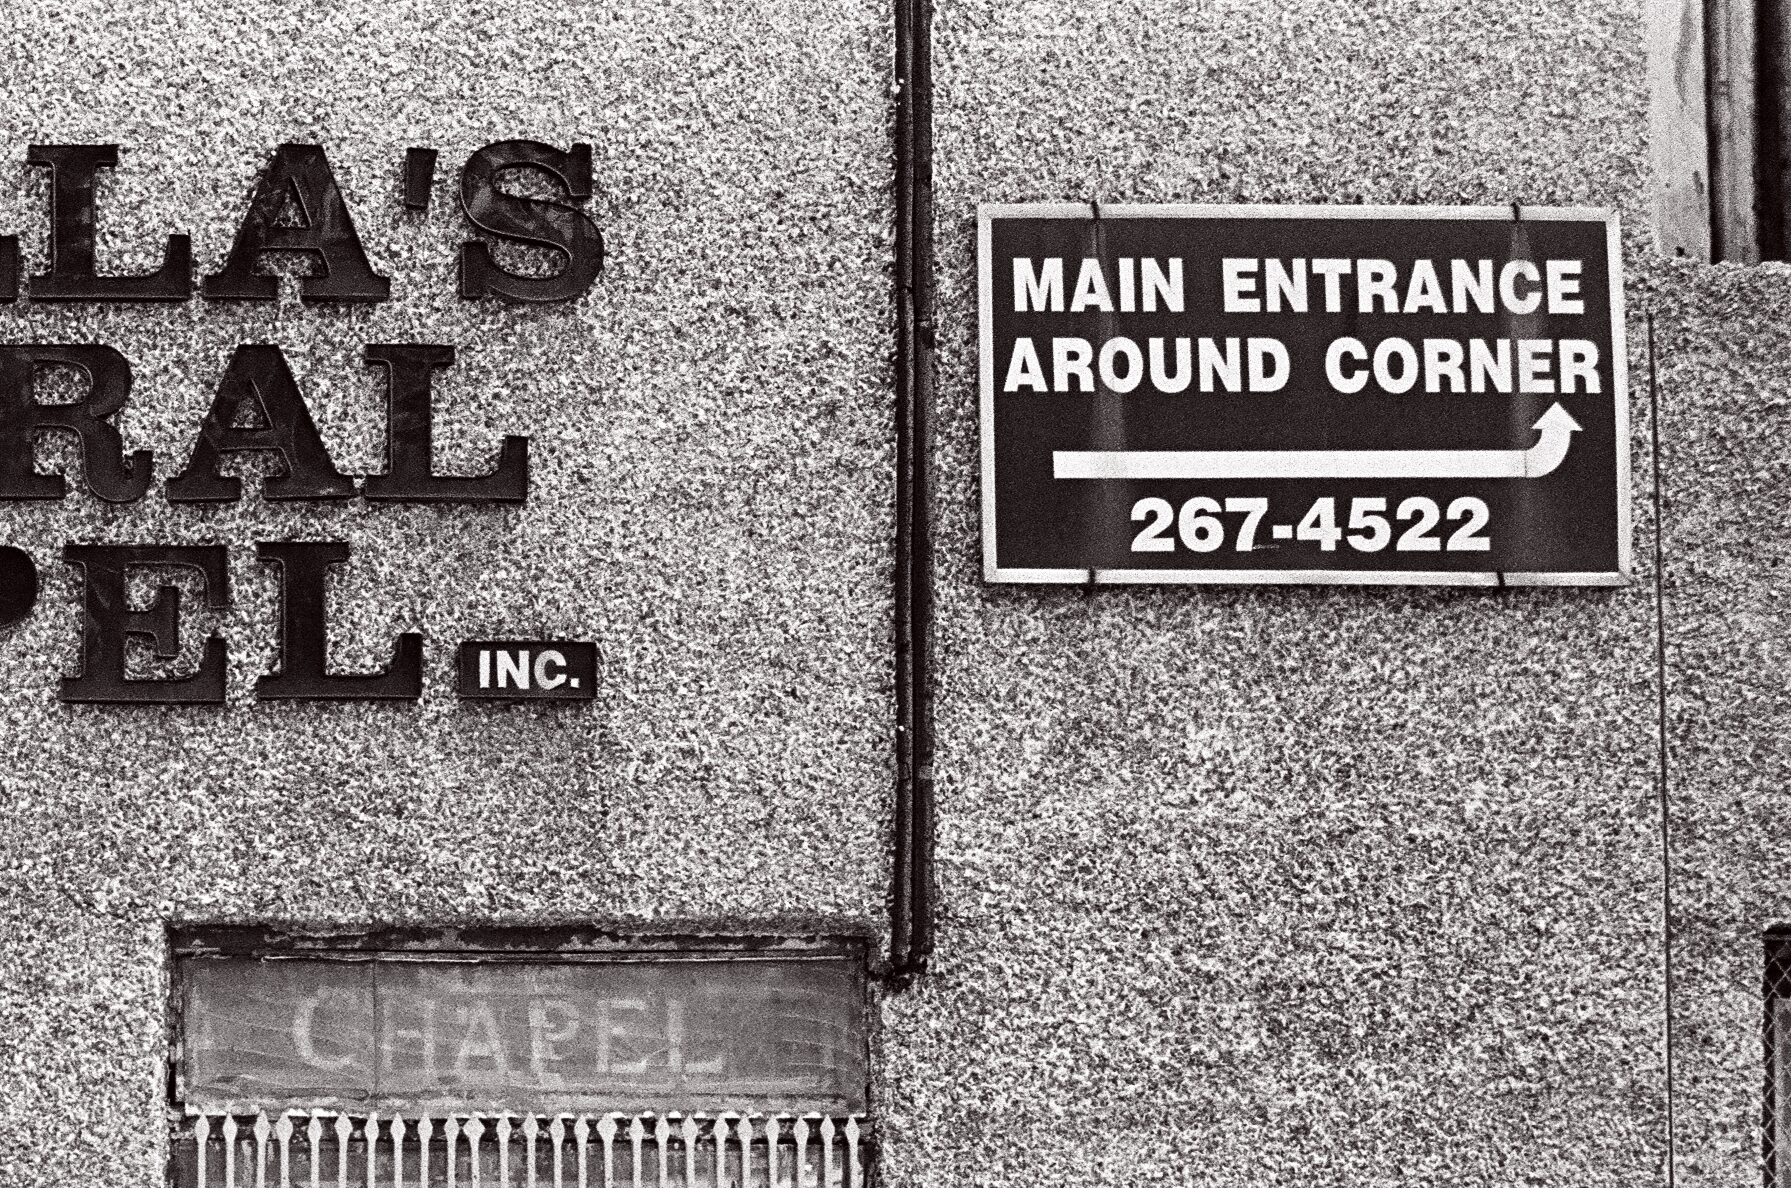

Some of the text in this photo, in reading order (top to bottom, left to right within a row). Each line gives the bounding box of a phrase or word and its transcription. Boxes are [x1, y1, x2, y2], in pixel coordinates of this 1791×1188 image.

[1012, 258, 1584, 314] MAIN ENTRANCE
[1004, 338, 1601, 394] AROUND CORNER
[1130, 497, 1491, 552] 267-4522
[478, 650, 580, 690] INC.
[293, 989, 724, 1084] CHAPEL
